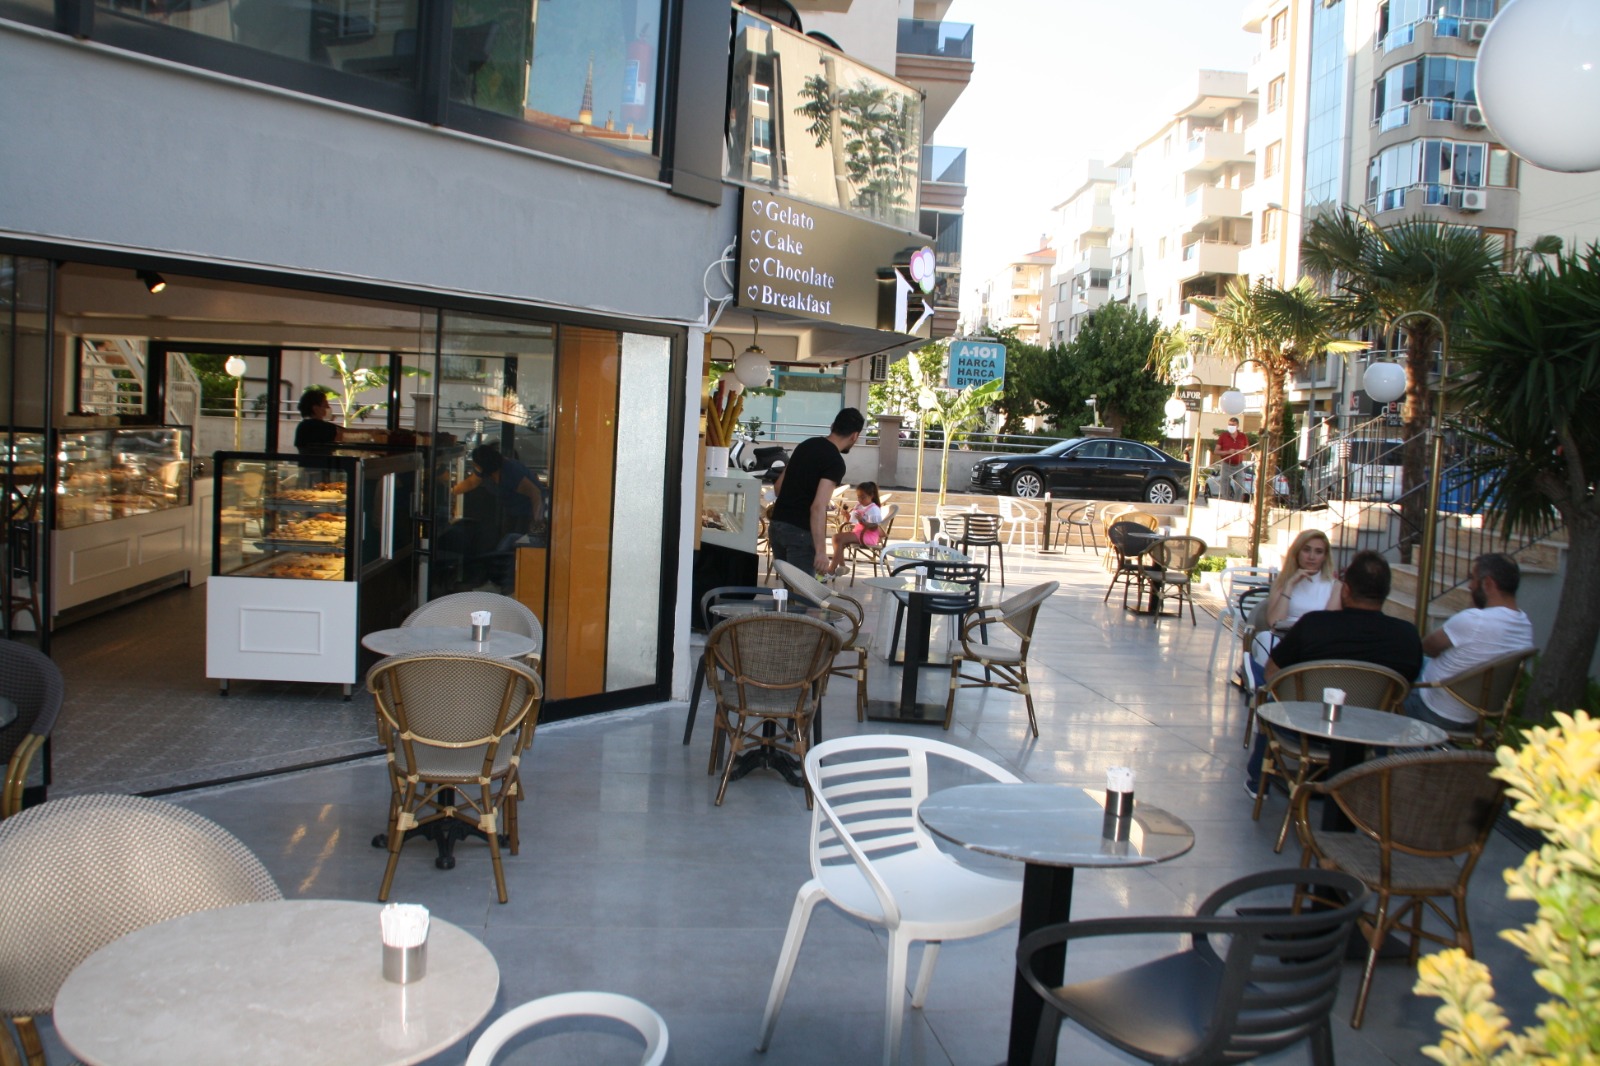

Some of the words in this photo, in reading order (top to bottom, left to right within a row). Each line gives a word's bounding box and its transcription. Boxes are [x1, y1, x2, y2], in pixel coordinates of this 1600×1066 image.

[765, 201, 814, 230] Gelato
[764, 229, 803, 255] Cake
[762, 257, 835, 289] Chocolate
[761, 285, 832, 315] Breakfast
[957, 368, 995, 378] HARCA
[958, 358, 996, 368] HARCA
